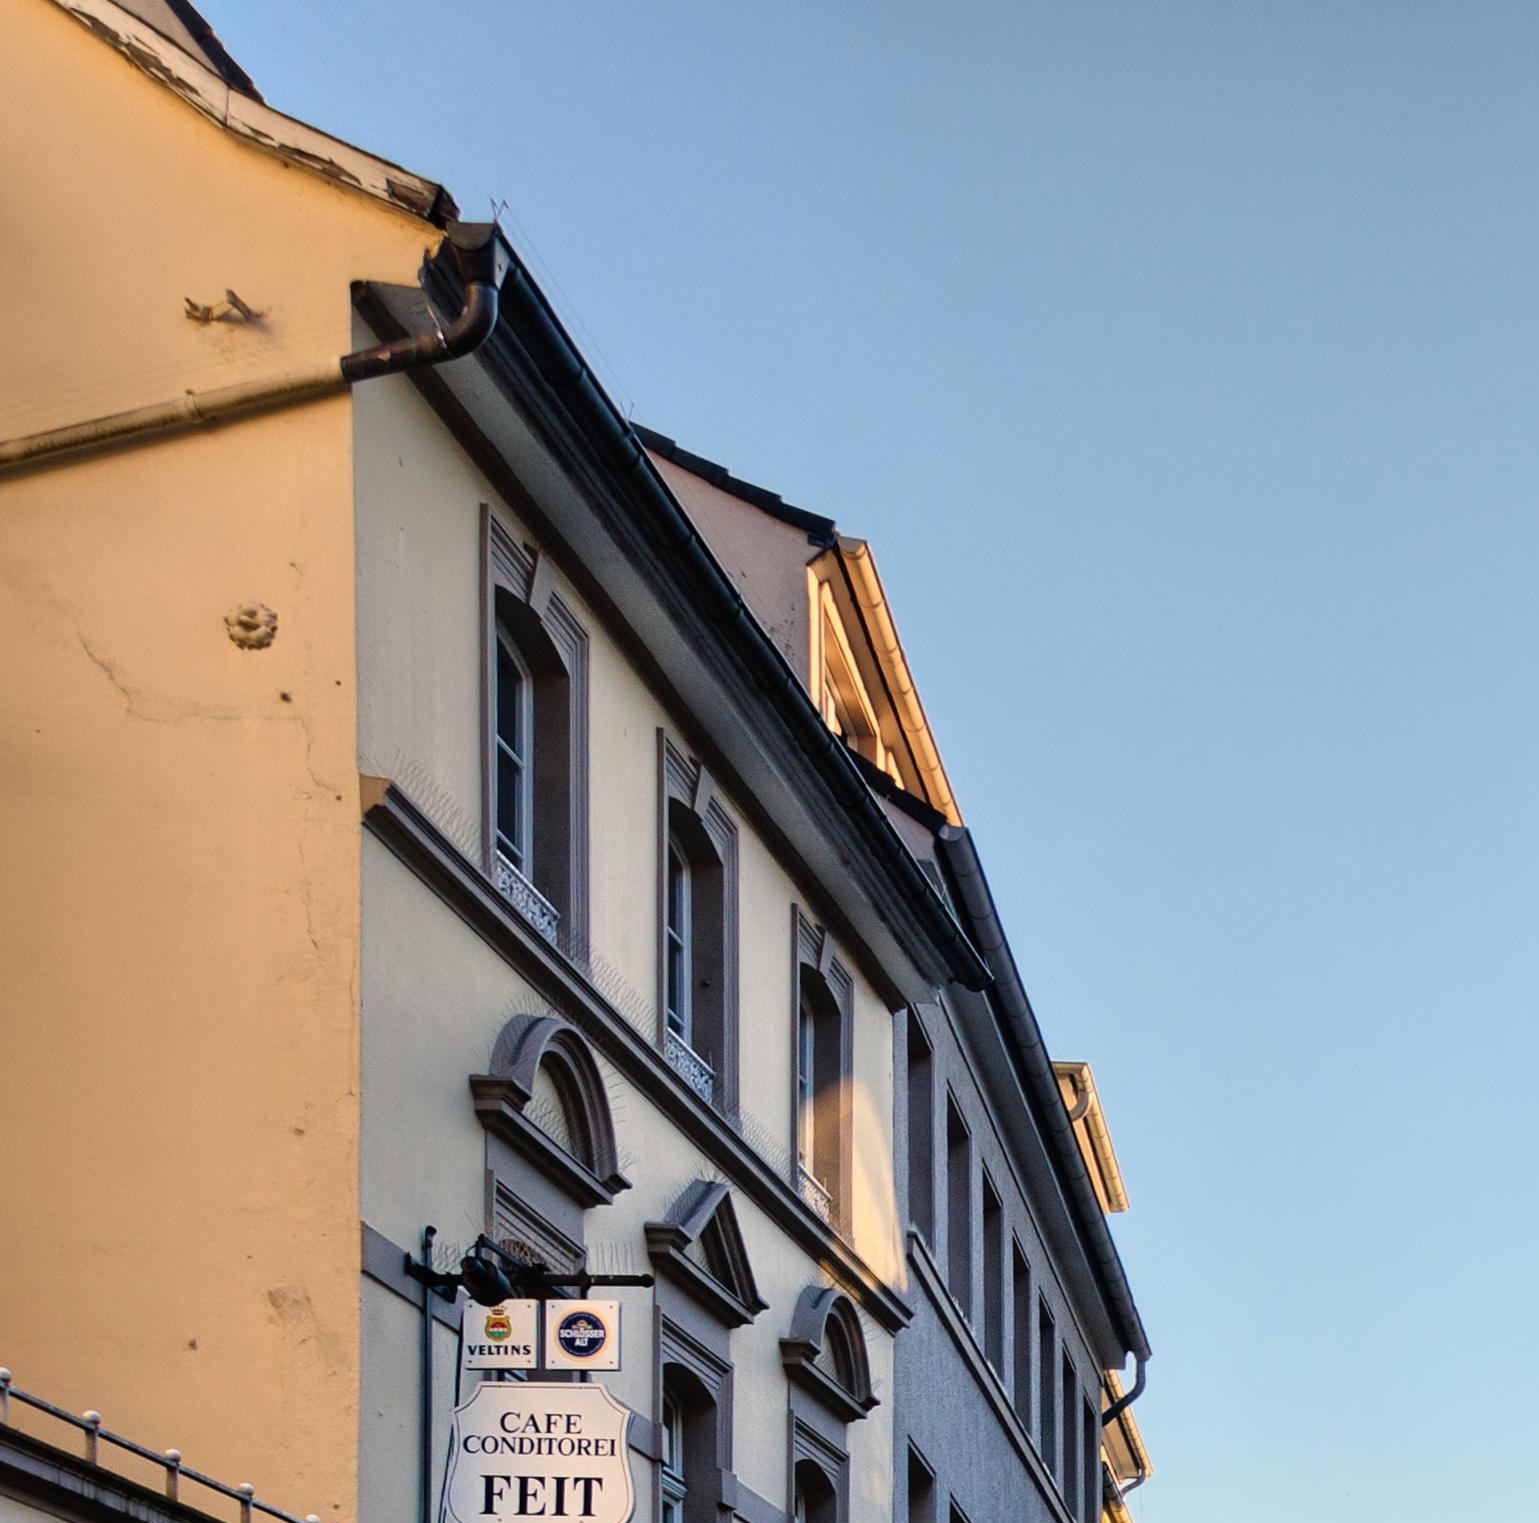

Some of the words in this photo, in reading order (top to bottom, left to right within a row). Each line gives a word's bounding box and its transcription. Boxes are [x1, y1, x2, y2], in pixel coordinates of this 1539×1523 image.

[467, 1344, 531, 1355] VELTINS
[574, 1338, 589, 1347] ALT
[500, 1411, 582, 1434] CAFE
[463, 1435, 616, 1457] CONDITOREI
[479, 1474, 603, 1517] FEIT
